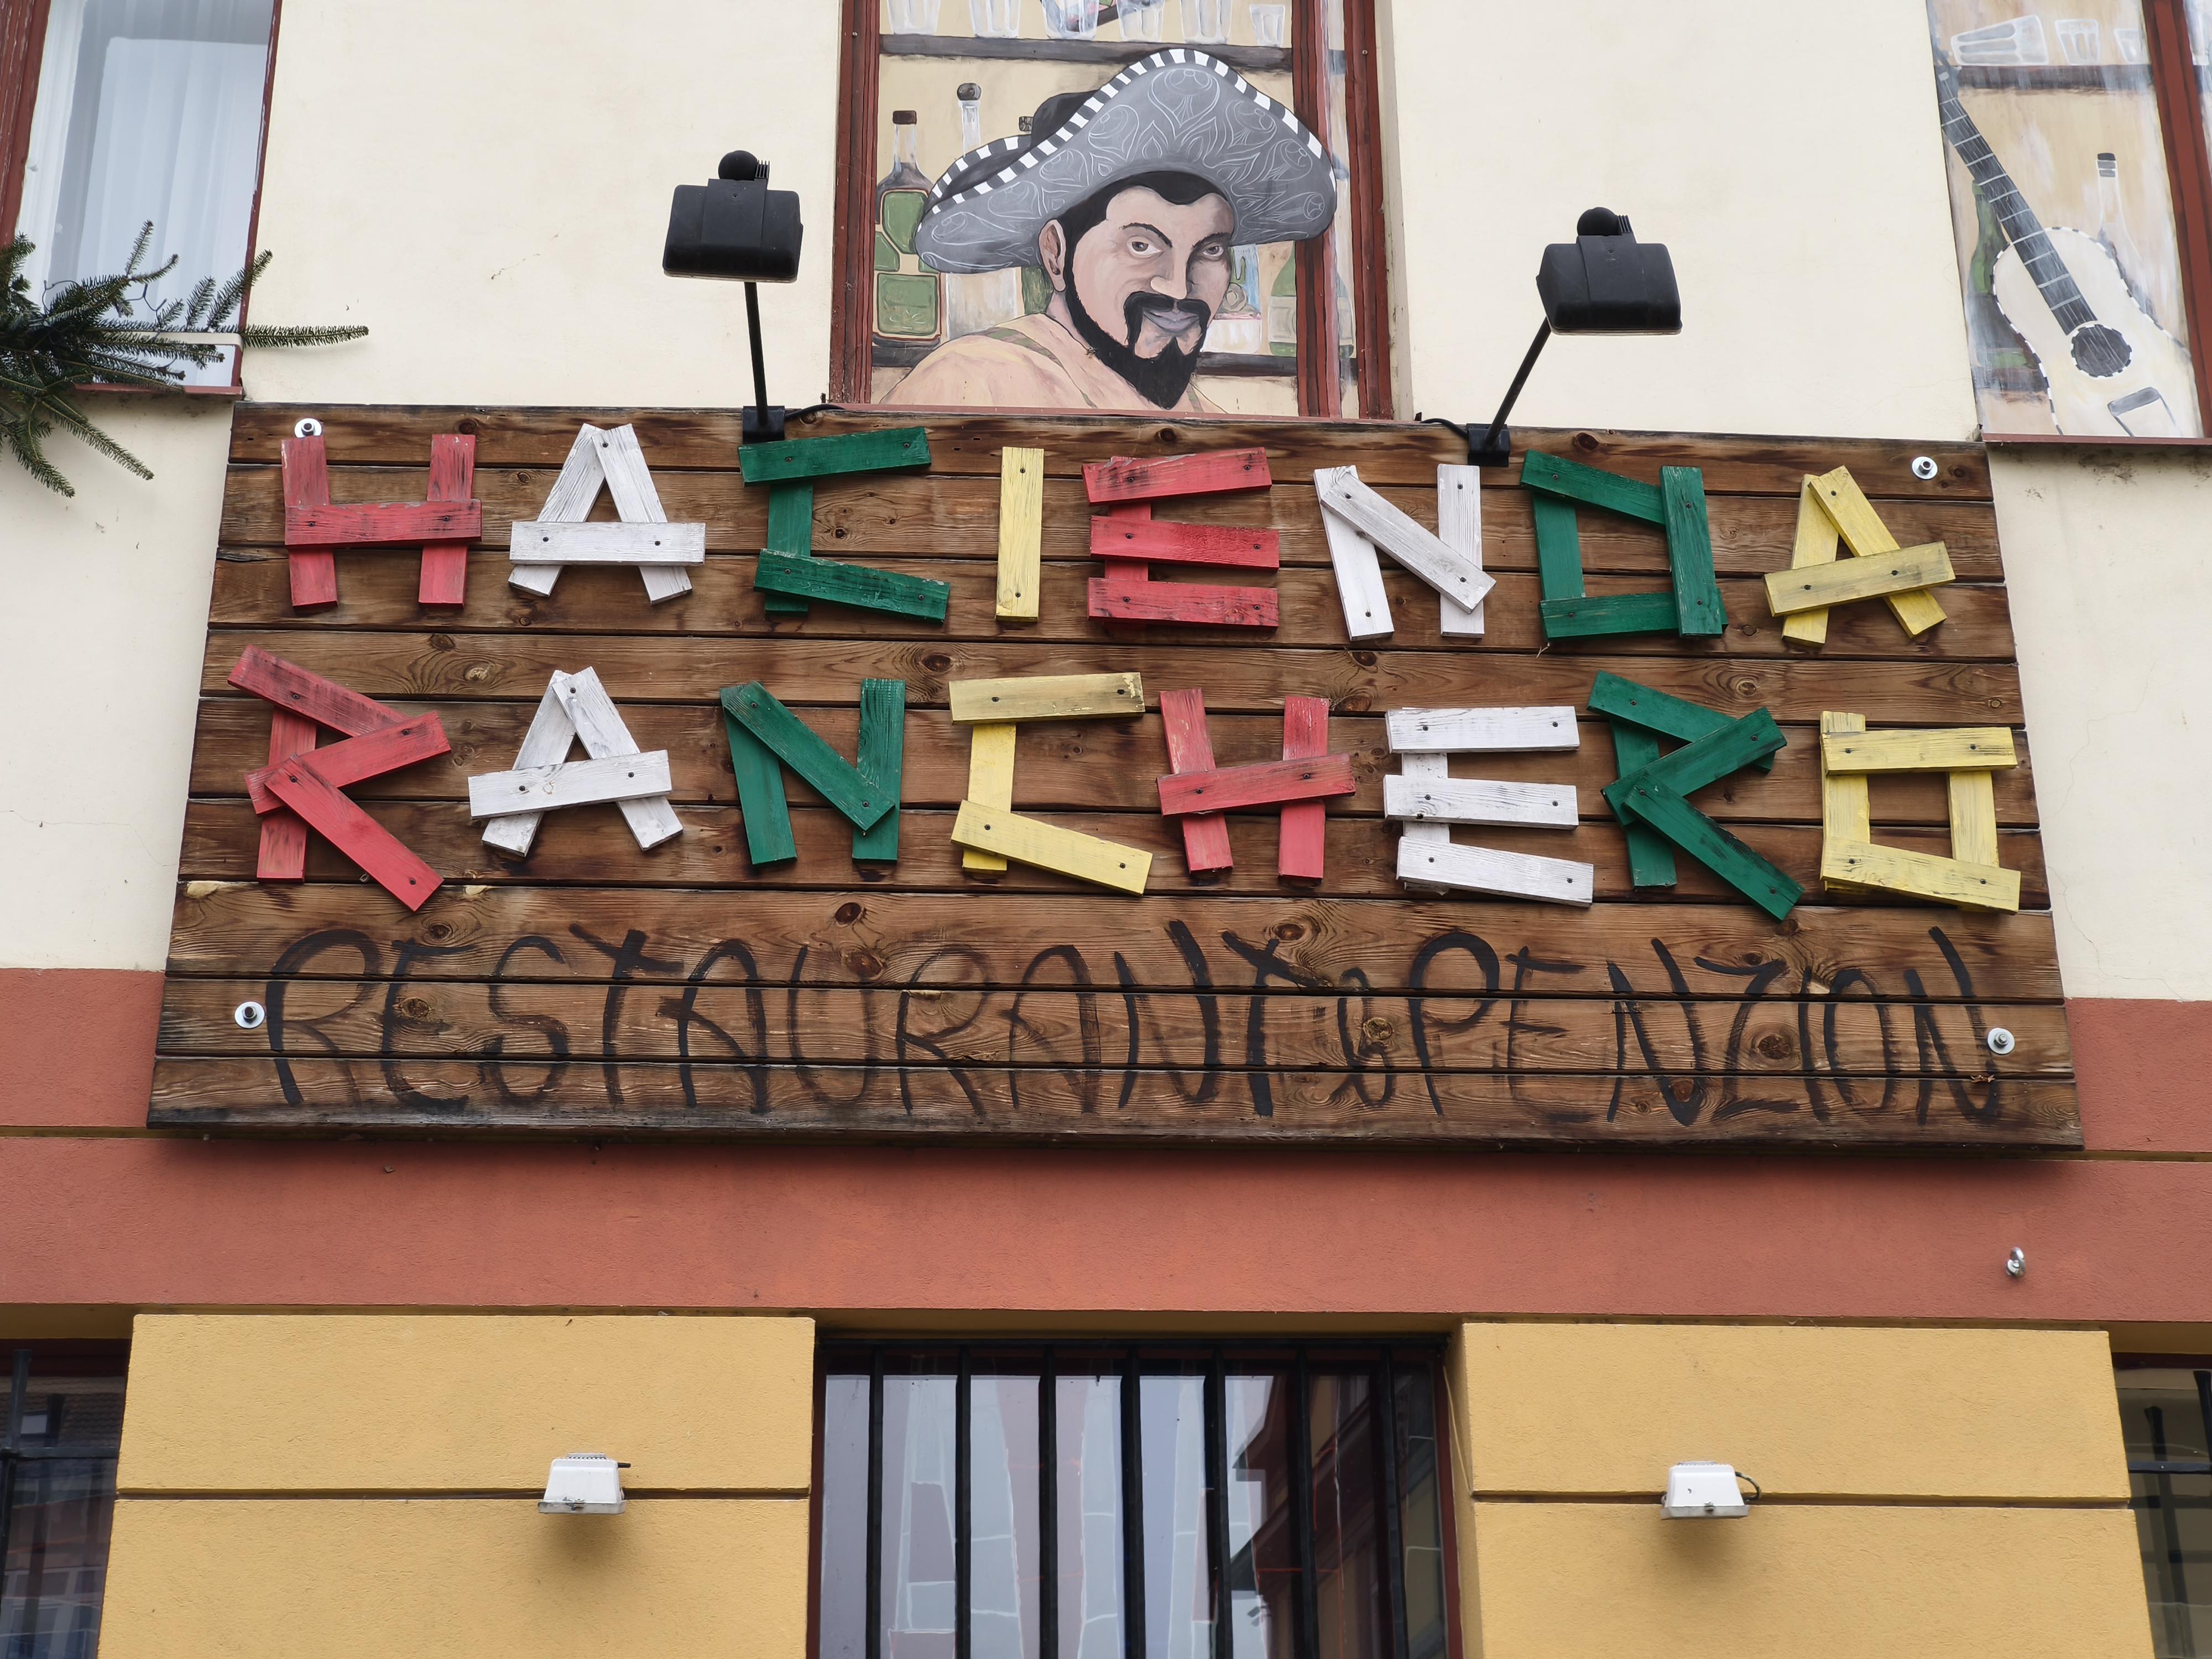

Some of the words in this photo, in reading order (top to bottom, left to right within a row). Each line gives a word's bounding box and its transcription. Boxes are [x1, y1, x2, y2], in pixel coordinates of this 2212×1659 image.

[281, 423, 1956, 646] HACIENDA
[227, 666, 2022, 921] RANCHERO
[266, 920, 1332, 1117] RESTAURANT
[1405, 926, 2001, 1126] PENZION
